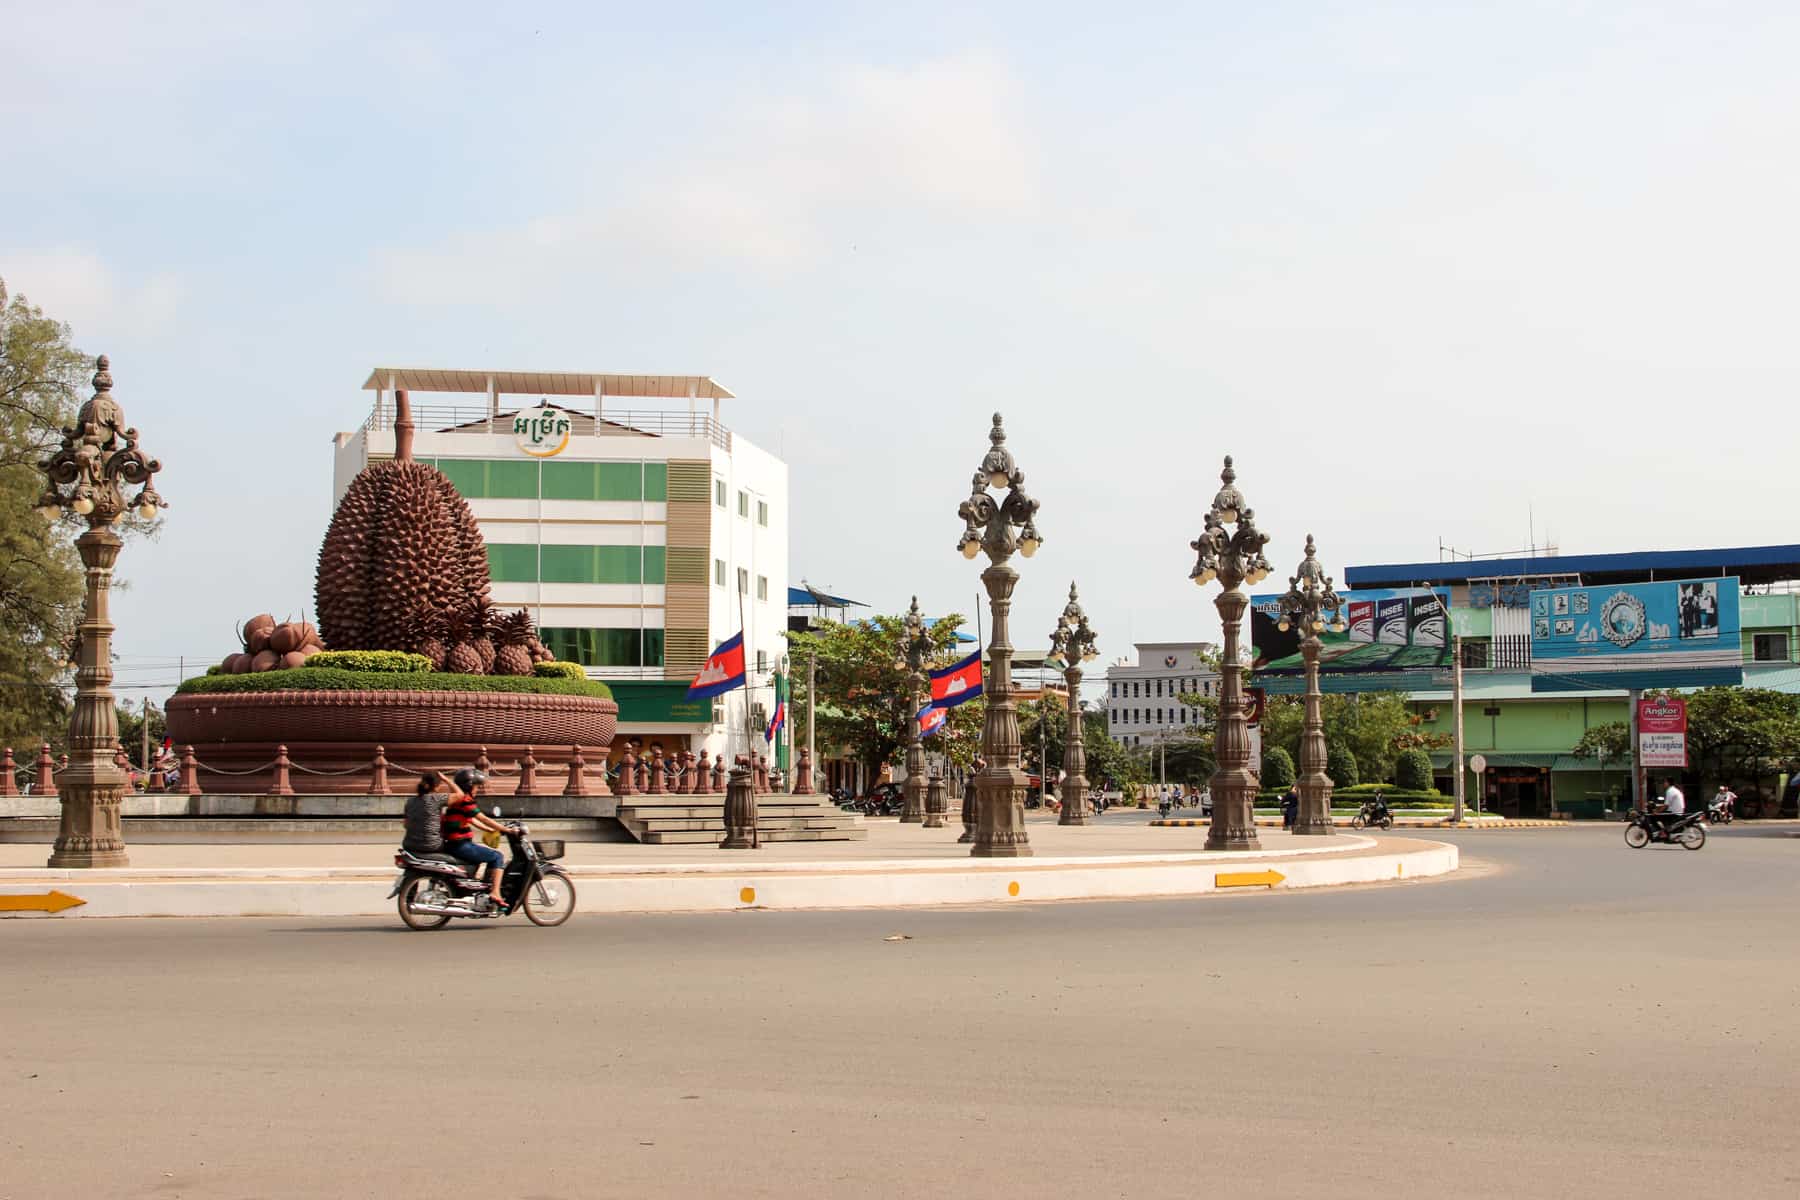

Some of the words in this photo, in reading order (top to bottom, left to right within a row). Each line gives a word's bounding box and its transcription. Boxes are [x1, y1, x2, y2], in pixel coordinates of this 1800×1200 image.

[1350, 605, 1371, 618] INSEE
[1380, 602, 1403, 617] INSEE
[1414, 600, 1440, 617] INSEE
